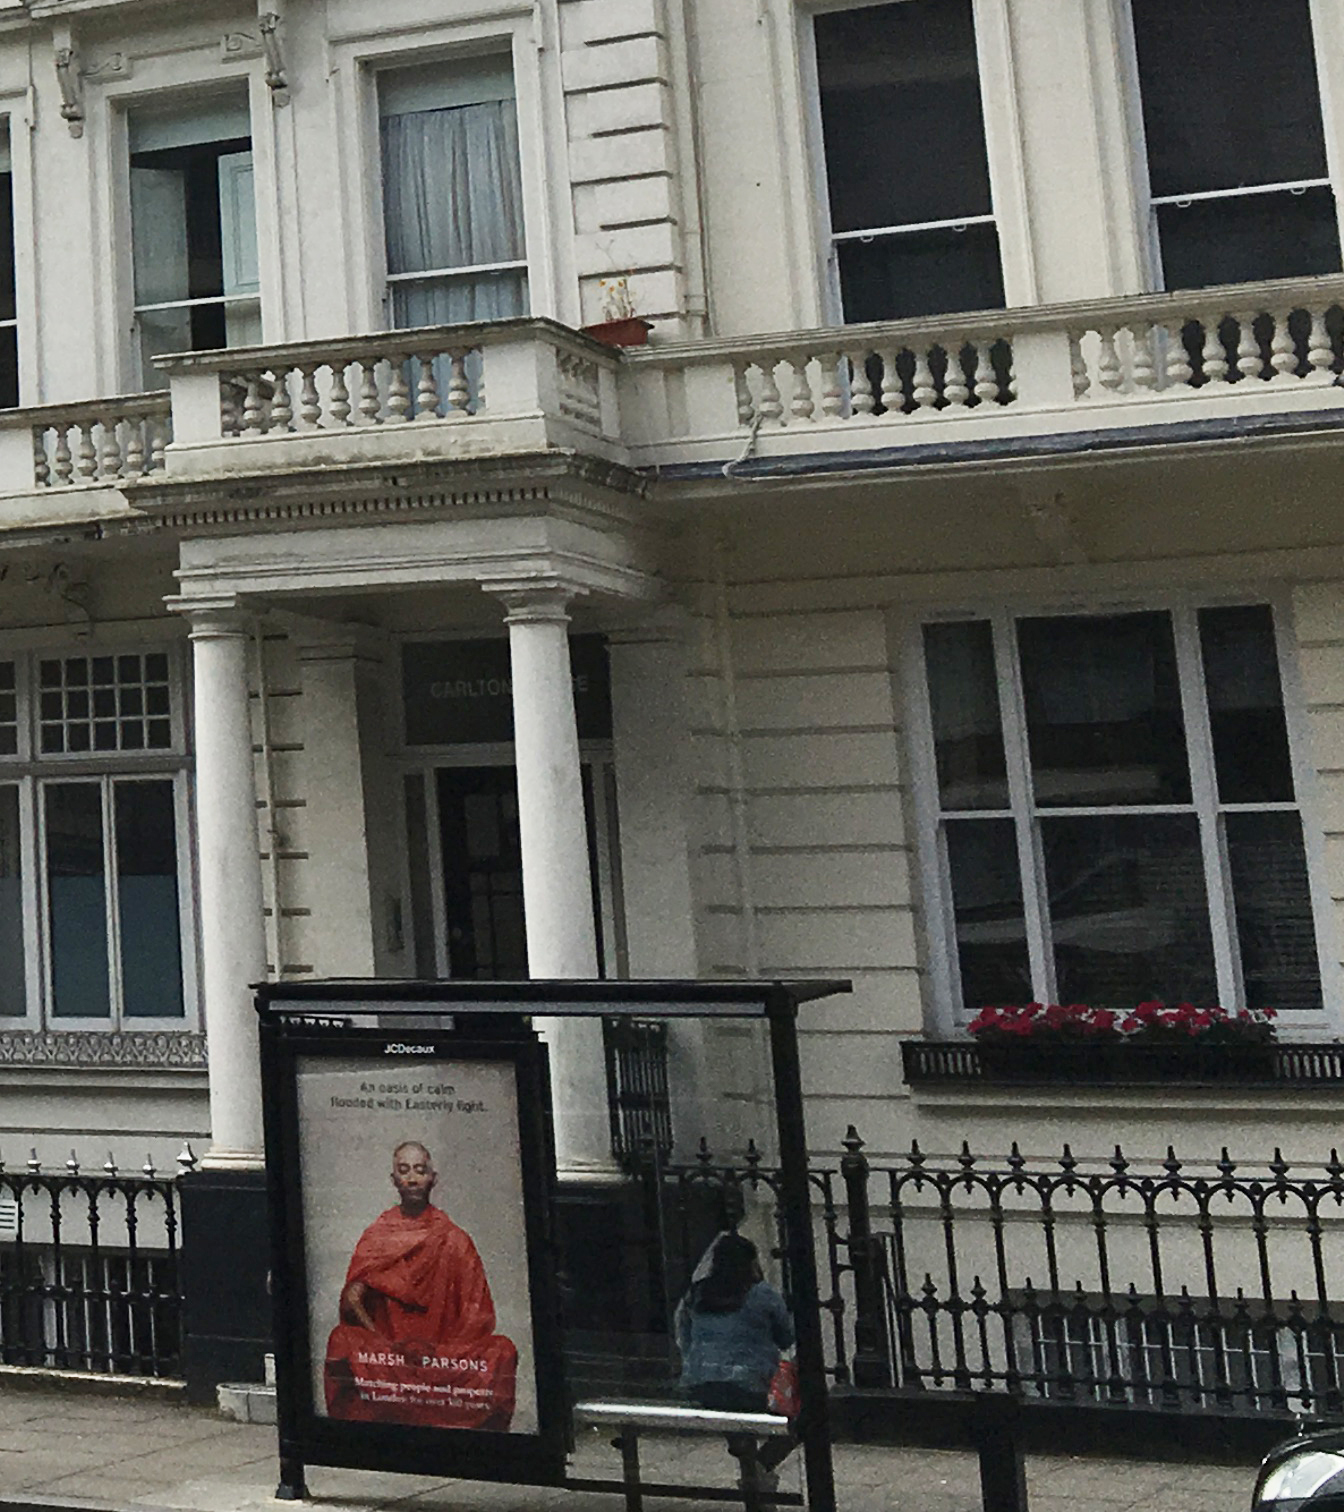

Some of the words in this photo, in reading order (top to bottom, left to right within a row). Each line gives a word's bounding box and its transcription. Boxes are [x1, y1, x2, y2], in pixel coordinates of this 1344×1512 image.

[384, 1043, 435, 1054] JCDecaux
[378, 1083, 408, 1094] oasis
[412, 1083, 423, 1094] of
[427, 1083, 456, 1095] calm
[377, 1097, 401, 1110] with
[405, 1098, 453, 1114] Easterly
[358, 1352, 406, 1367] MARSH
[422, 1356, 488, 1373] PARSONS
